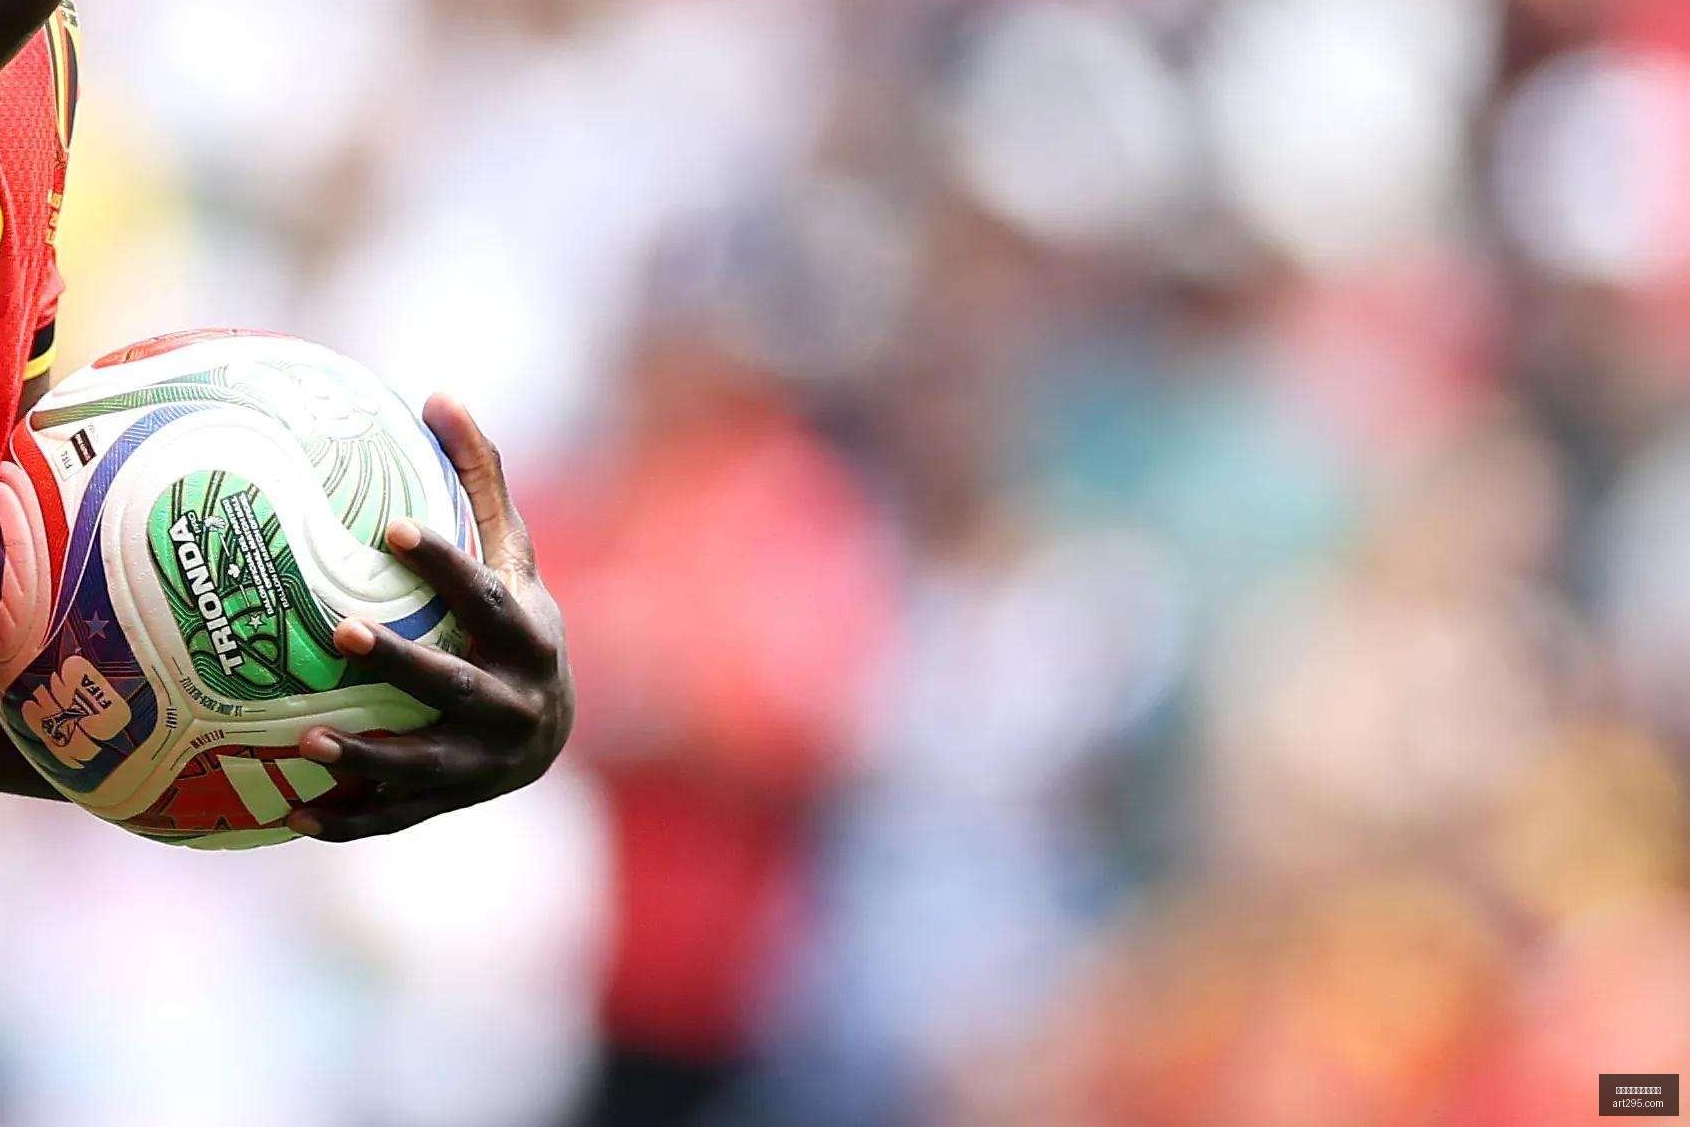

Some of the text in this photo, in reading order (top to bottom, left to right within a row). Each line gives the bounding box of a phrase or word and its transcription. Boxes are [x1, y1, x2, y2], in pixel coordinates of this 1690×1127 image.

[187, 510, 201, 533] PRO
[231, 495, 245, 518] BALL
[238, 535, 249, 552] DEL
[240, 517, 257, 549] MATCH
[254, 529, 271, 561] MATCH
[266, 561, 276, 574] DE
[169, 515, 241, 675] TRIONDA
[271, 573, 290, 609] BALLON
[81, 674, 113, 710] FIFA
